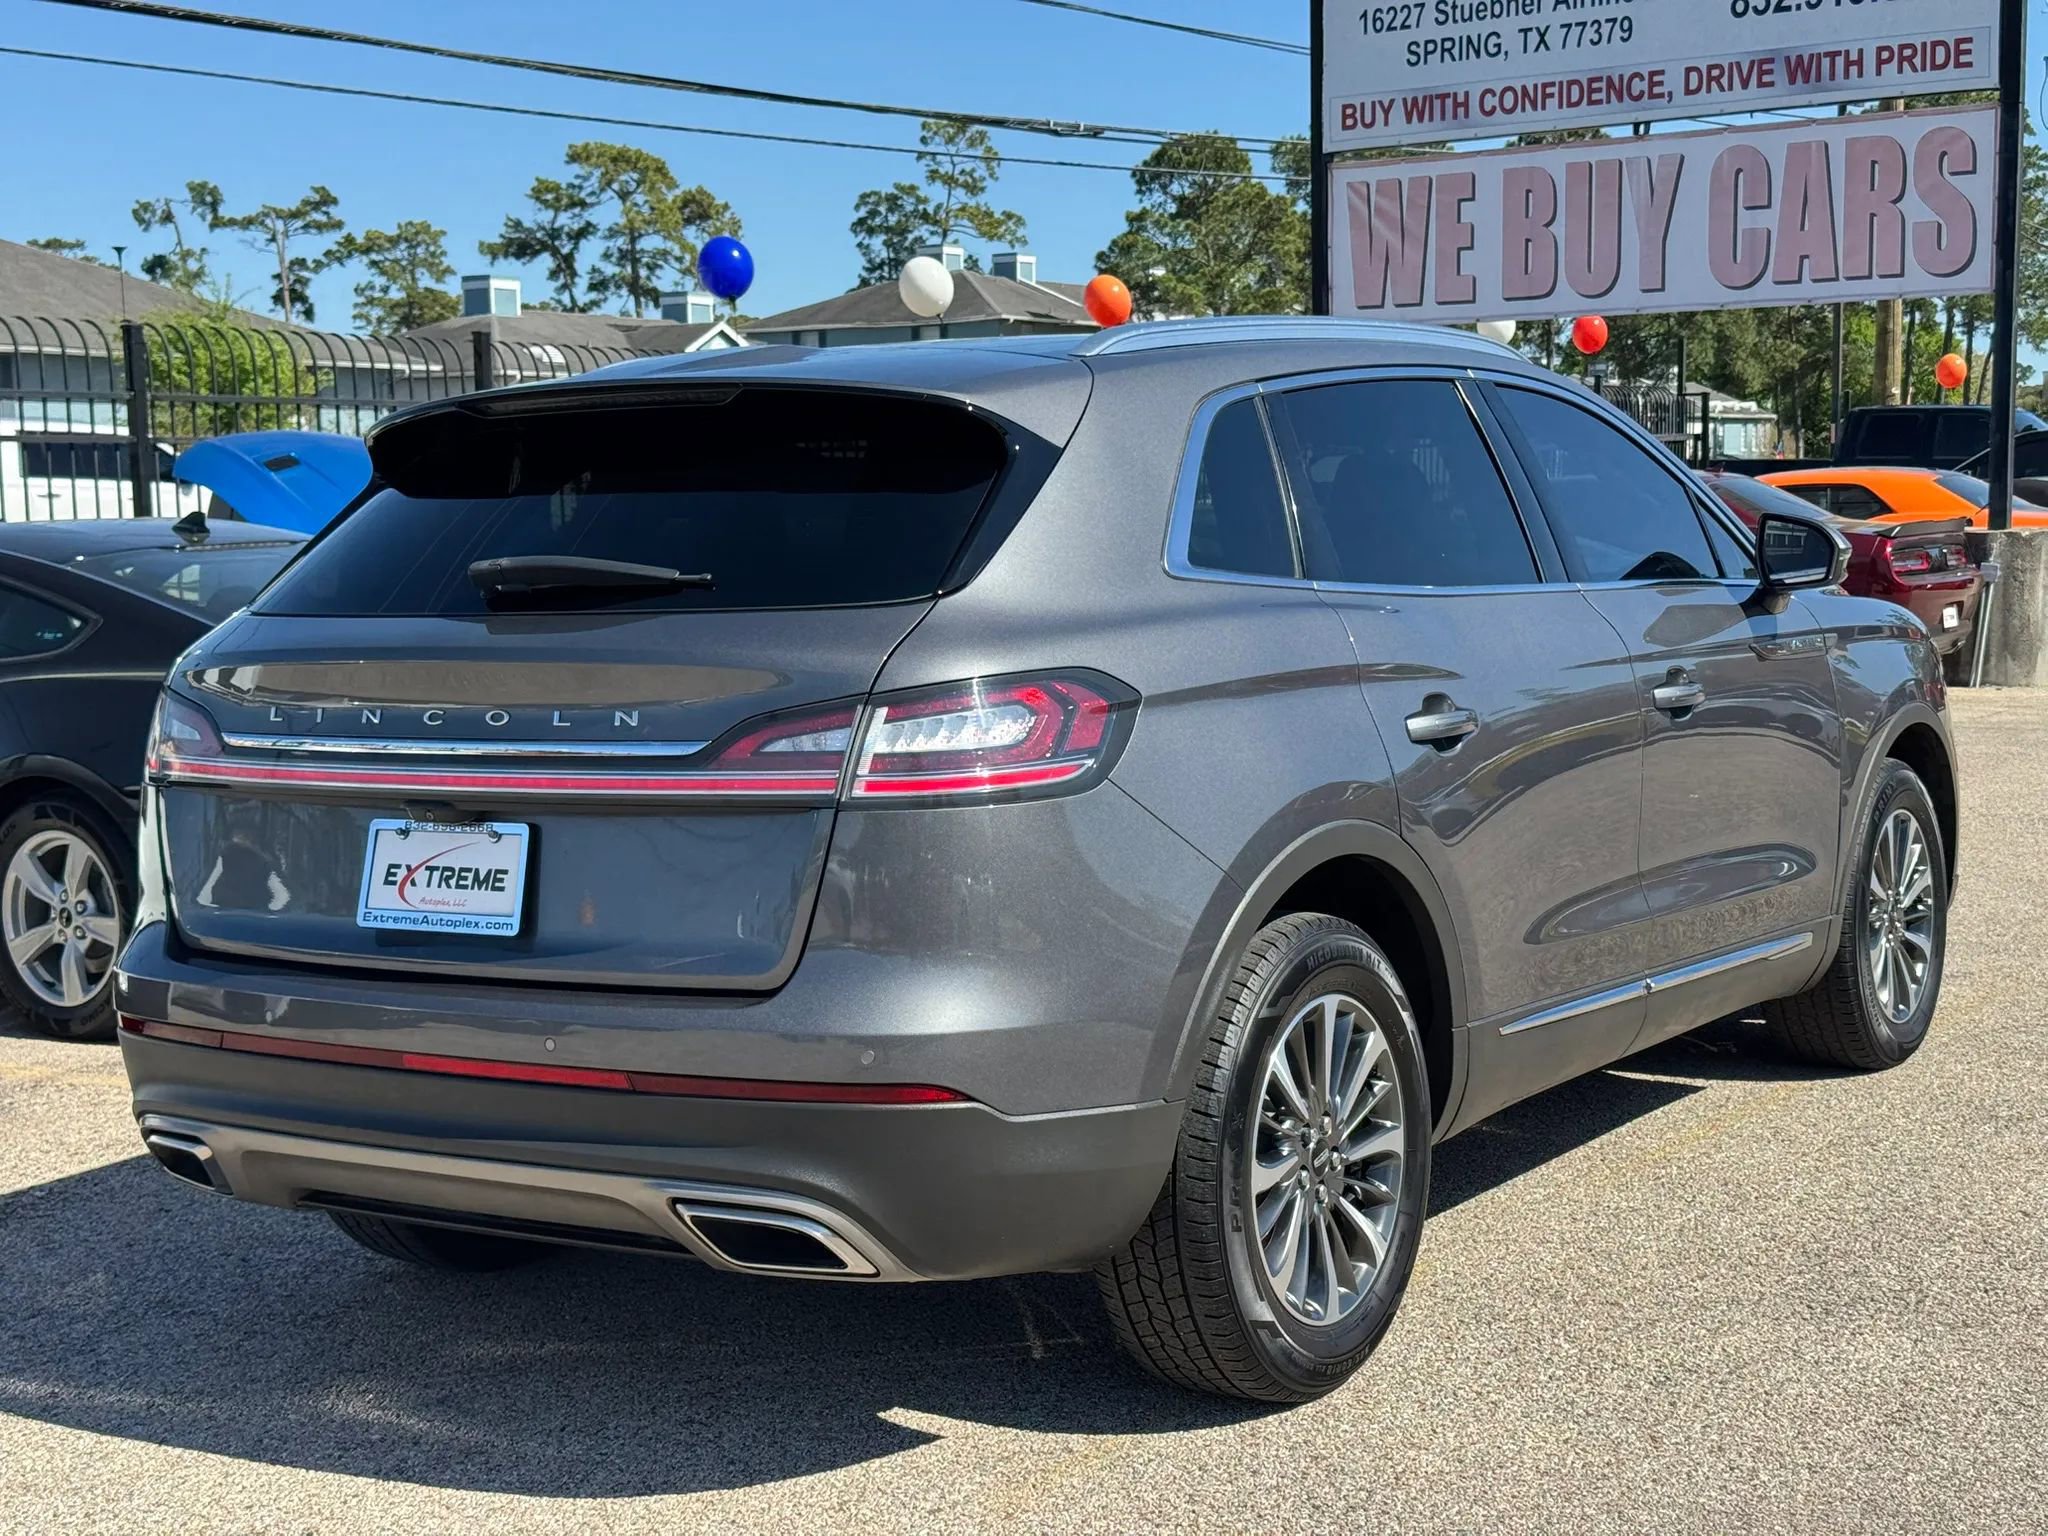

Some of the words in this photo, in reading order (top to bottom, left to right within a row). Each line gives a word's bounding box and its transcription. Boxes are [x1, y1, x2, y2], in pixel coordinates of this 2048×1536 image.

[1359, 3, 1426, 35] 16227
[1434, 0, 1542, 26] Stuebner
[1406, 31, 1509, 67] SPRING,
[1518, 24, 1551, 54] TX
[1559, 16, 1633, 50] 77379
[1341, 98, 1395, 131] BUY
[1402, 90, 1470, 125] WITH
[1478, 69, 1673, 118] CONFIDENCE,
[1684, 57, 1775, 97] DRIVE
[1784, 48, 1863, 86] WITH
[1875, 36, 1974, 77] PRIDE
[1347, 171, 1476, 309] WE
[1502, 153, 1685, 301] BUY
[1708, 126, 1978, 290] CARS
[269, 706, 640, 727] LINCOLN
[383, 863, 509, 892] EXTREME
[362, 911, 514, 931] ExtremeAutoplex.com
